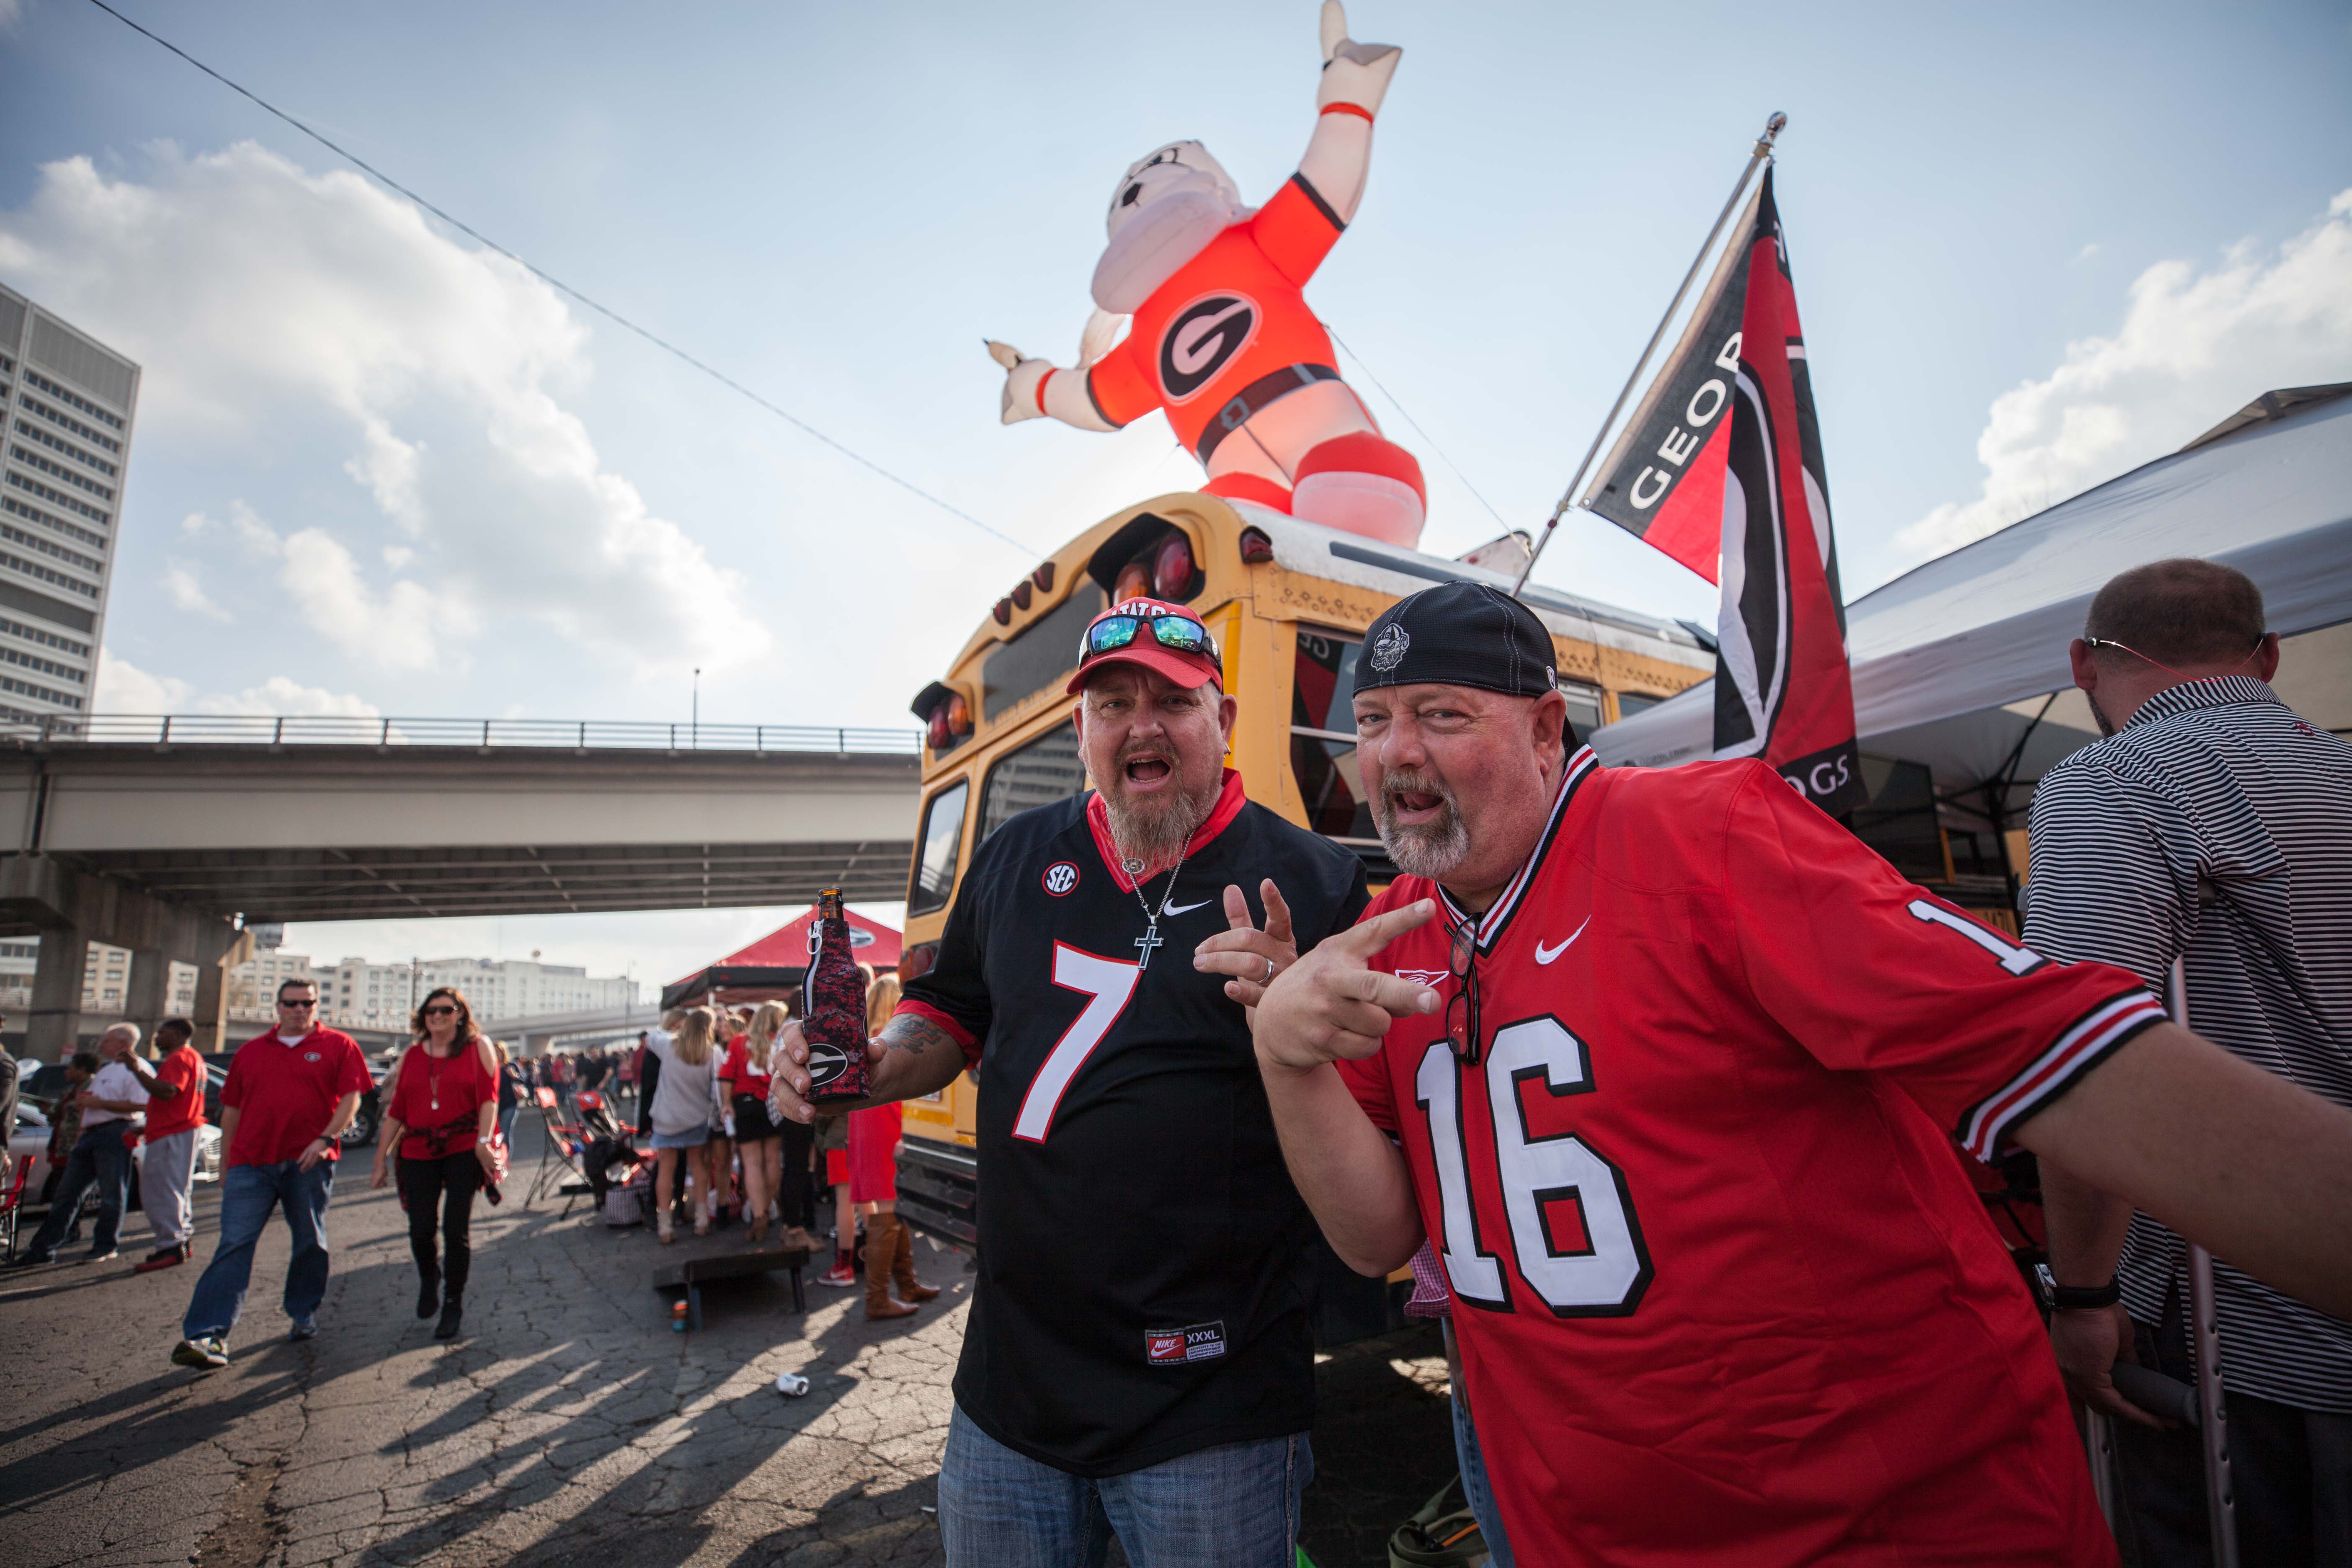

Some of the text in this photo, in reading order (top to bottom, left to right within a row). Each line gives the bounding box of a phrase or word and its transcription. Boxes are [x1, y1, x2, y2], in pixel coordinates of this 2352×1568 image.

[1047, 865, 1075, 892] SEC
[1011, 939, 1143, 1145] 7
[1415, 1012, 1656, 1318] 16
[1155, 1339, 1176, 1348] NIKE
[1187, 1330, 1220, 1344] XXXL
